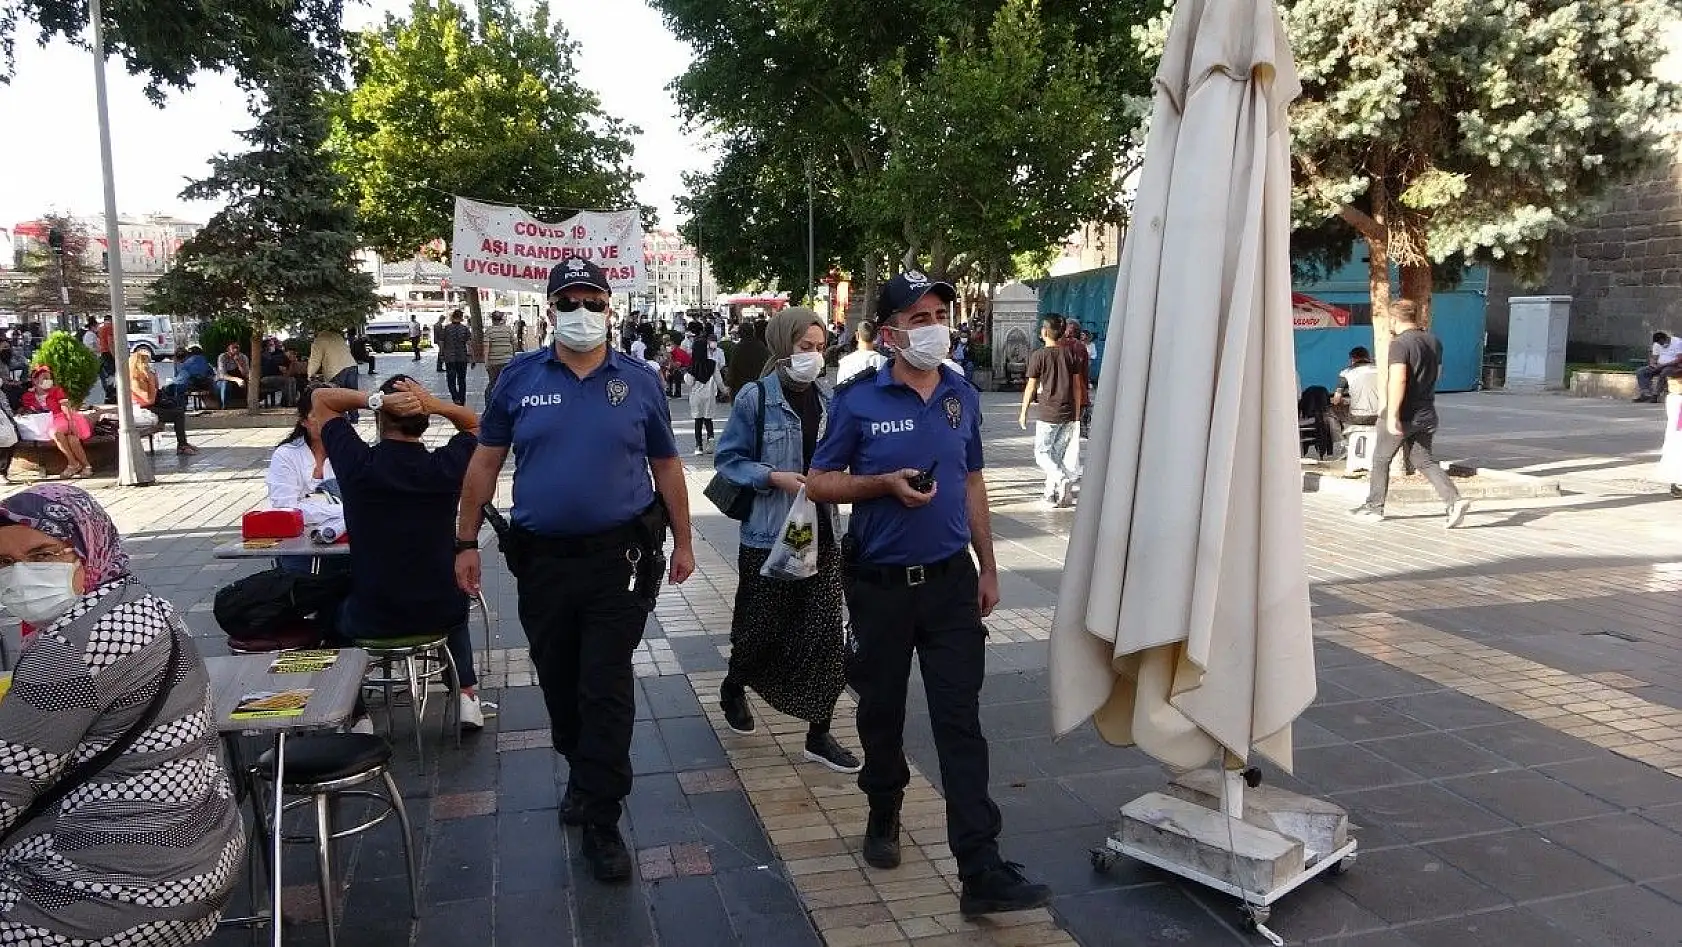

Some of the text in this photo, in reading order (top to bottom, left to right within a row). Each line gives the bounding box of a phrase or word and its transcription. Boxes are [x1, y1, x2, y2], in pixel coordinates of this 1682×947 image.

[514, 221, 586, 240] COVID 19
[481, 238, 618, 260] AŞI RANDEVU VE
[463, 259, 548, 280] UYGULAM
[521, 394, 562, 408] POLIS
[871, 419, 914, 436] POLIS
